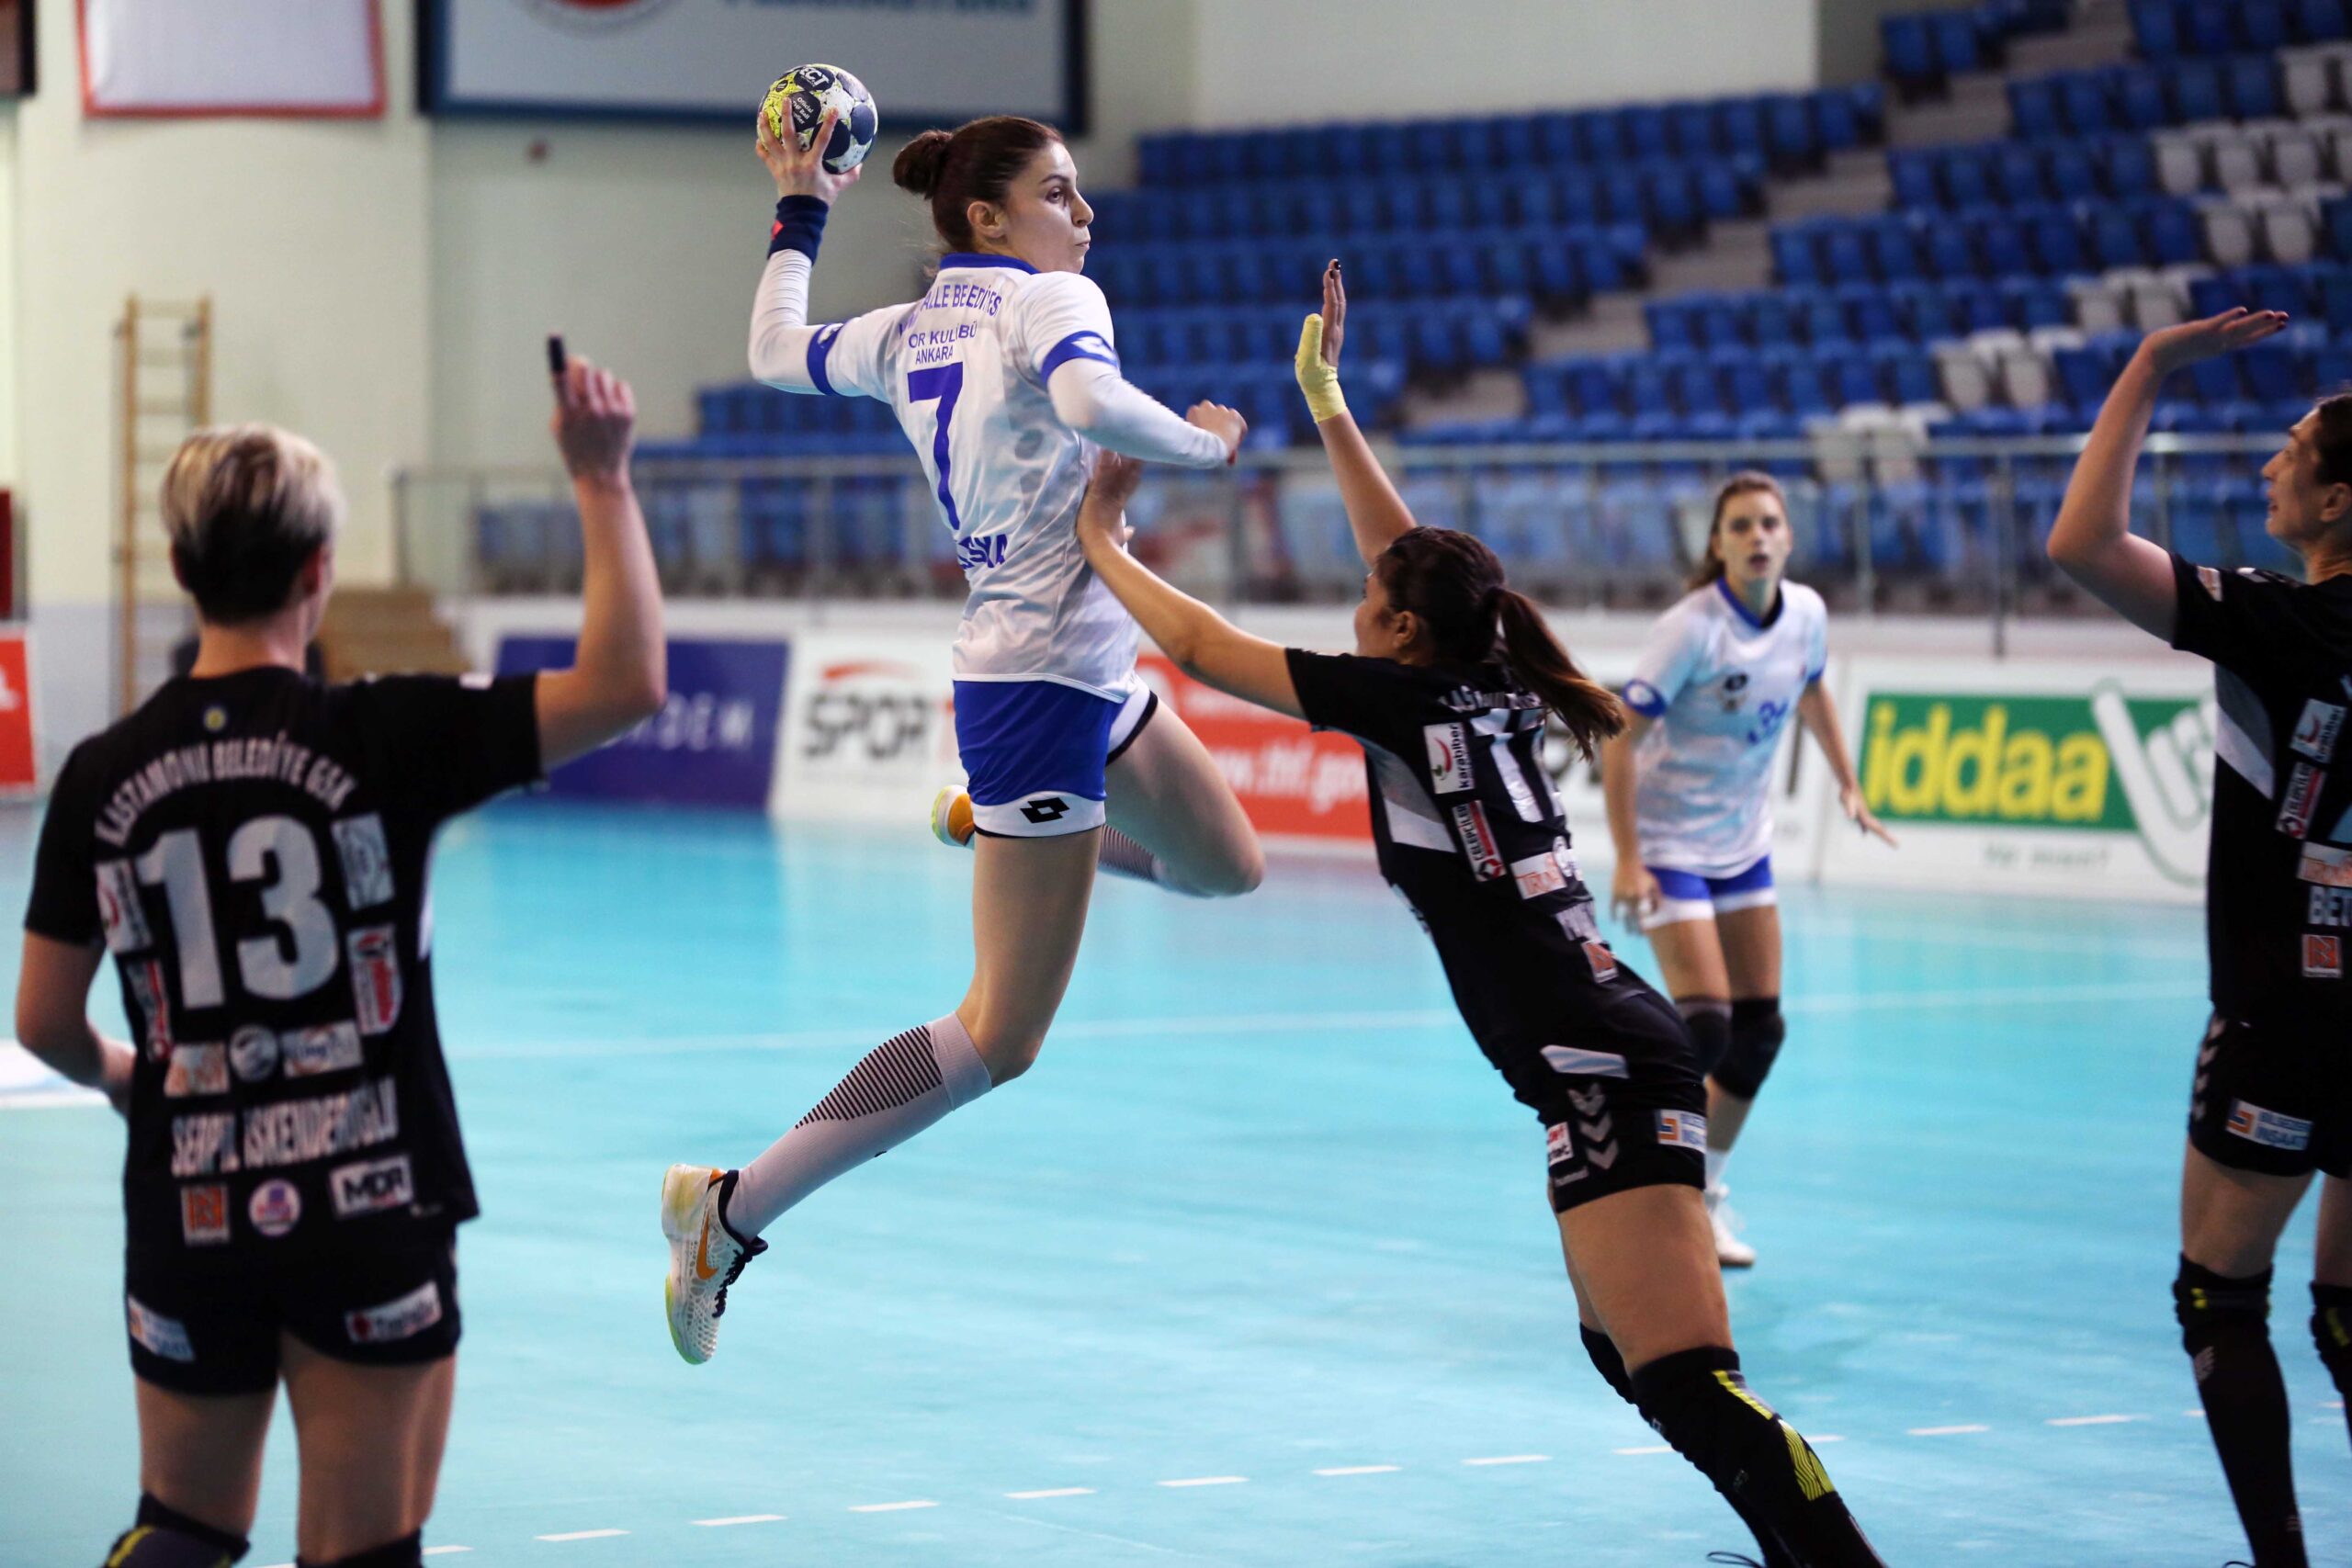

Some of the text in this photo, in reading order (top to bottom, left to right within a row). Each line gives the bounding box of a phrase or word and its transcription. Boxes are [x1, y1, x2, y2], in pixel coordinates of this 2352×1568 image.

[797, 97, 814, 113] Official
[799, 109, 810, 119] Ball
[916, 345, 954, 365] ANKARA
[908, 362, 963, 530] 7
[806, 692, 928, 761] SPOR
[304, 756, 357, 811] GSK
[1865, 701, 2111, 822] iddaa
[137, 815, 337, 1010] 13
